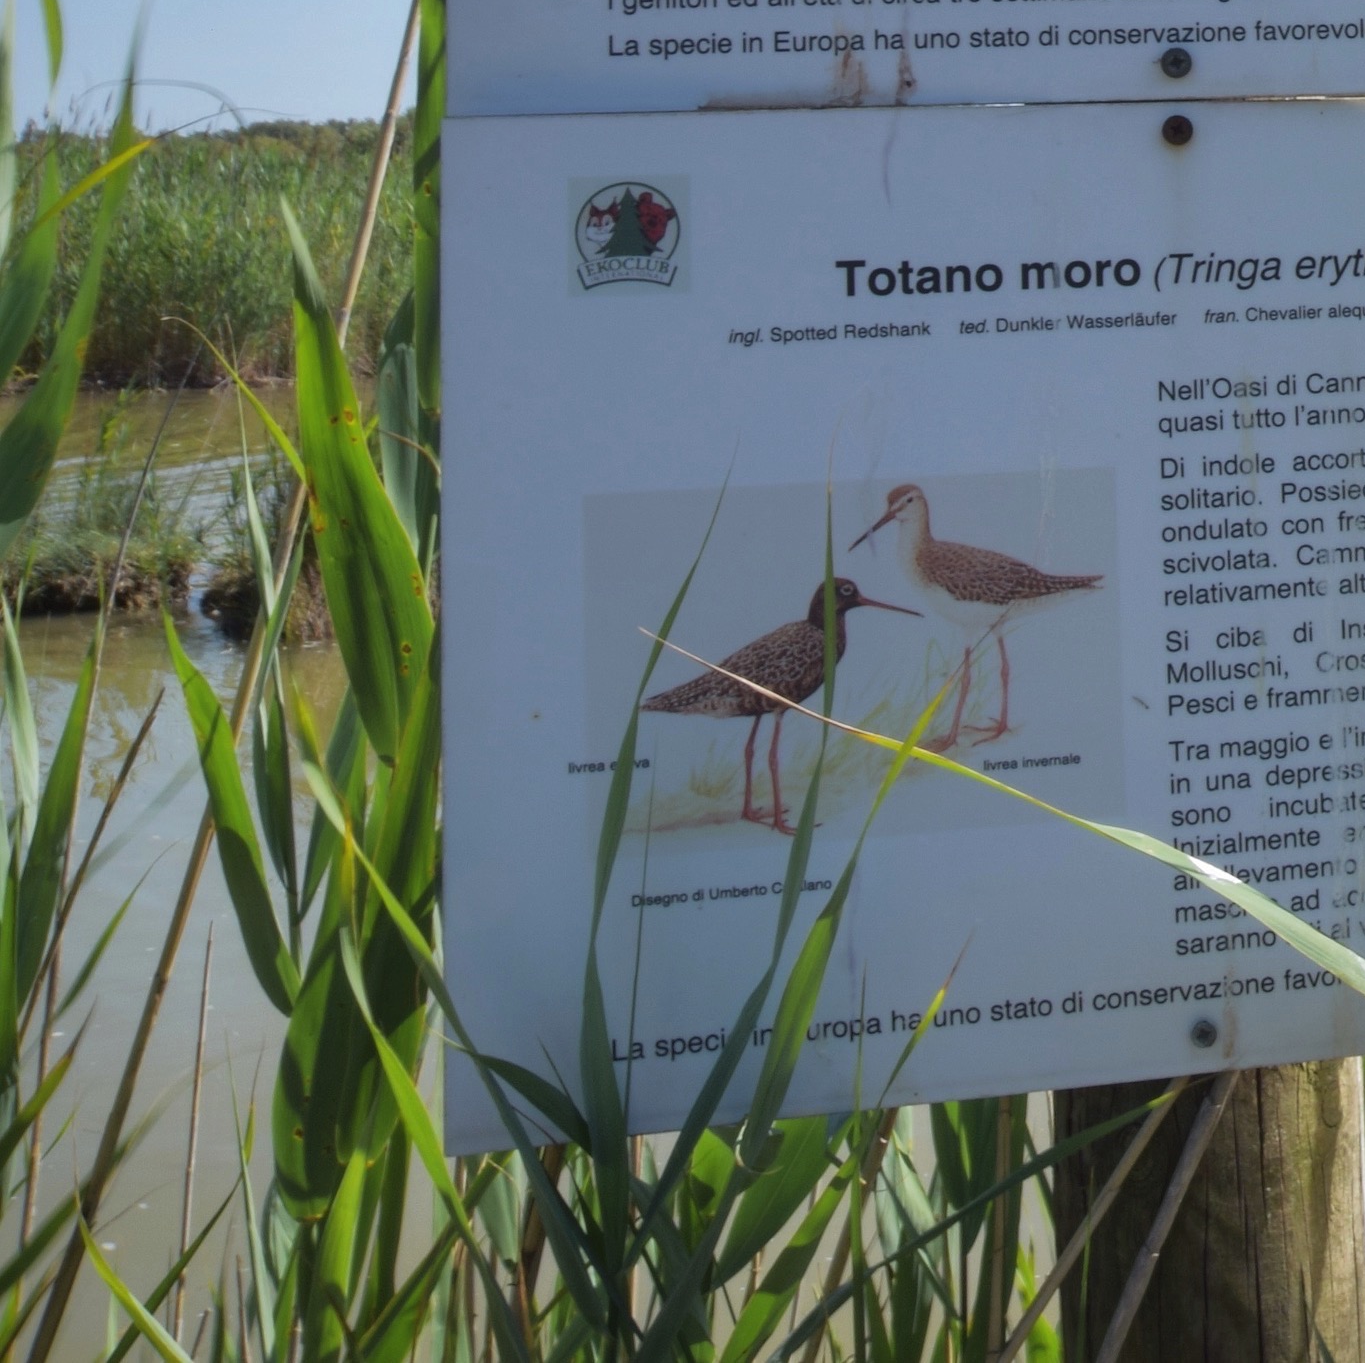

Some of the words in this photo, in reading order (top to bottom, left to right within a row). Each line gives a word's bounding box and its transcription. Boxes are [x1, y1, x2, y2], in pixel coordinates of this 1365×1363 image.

[649, 33, 732, 60] specie
[774, 31, 865, 60] Europa
[914, 32, 960, 49] uno
[970, 28, 1030, 48] stato
[1068, 22, 1246, 46] conservazione
[585, 257, 670, 277] EKOCLUB
[836, 260, 1003, 296] Totano
[1021, 259, 1141, 290] moro
[1154, 253, 1281, 292] (Tringa
[729, 328, 763, 347] ingl.
[770, 325, 837, 345] Spotted
[844, 322, 930, 339] Redshank
[960, 319, 989, 334] ted.
[1067, 312, 1177, 329] Wasserläufer
[1204, 309, 1238, 323] fran.
[1245, 306, 1322, 322] Chevalier
[1158, 376, 1267, 401] Nell'Oasi
[1158, 410, 1223, 438] quasi
[1203, 453, 1275, 476] indole
[1161, 486, 1262, 511] solitario.
[1162, 518, 1268, 543] ondulato
[1281, 517, 1324, 535] con
[1163, 550, 1276, 575] scivolata.
[1216, 627, 1263, 649] ciba
[1167, 656, 1288, 684] Molluschi,
[1168, 691, 1234, 716] Pesci
[1169, 740, 1210, 761] Tra
[1220, 732, 1309, 760] maggio
[568, 762, 605, 774] livrea
[983, 760, 1018, 771] livrea
[1022, 754, 1081, 767] invernale
[1206, 772, 1251, 792] una
[1171, 806, 1231, 827] sono
[709, 885, 768, 900] Umberto
[1176, 929, 1277, 956] saranno
[991, 998, 1053, 1022] stato
